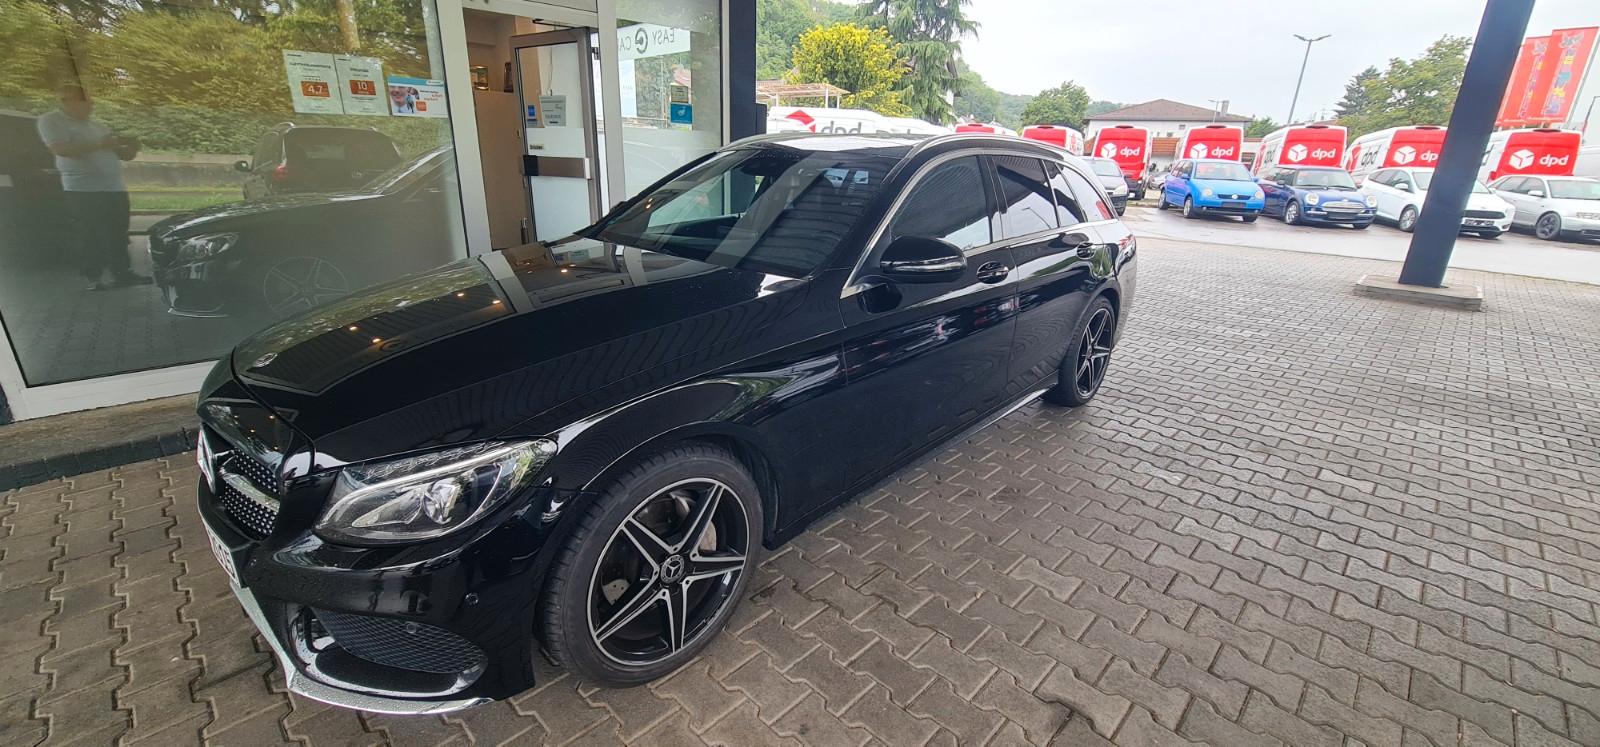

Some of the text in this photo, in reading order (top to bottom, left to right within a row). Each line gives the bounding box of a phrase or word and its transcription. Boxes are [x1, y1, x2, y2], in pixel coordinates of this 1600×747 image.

[357, 82, 368, 90] 10
[1120, 147, 1140, 158] dpd
[1211, 146, 1234, 158] dpd
[1311, 147, 1336, 160] dpd
[1361, 147, 1379, 167] dpd
[1539, 154, 1570, 167] dpd
